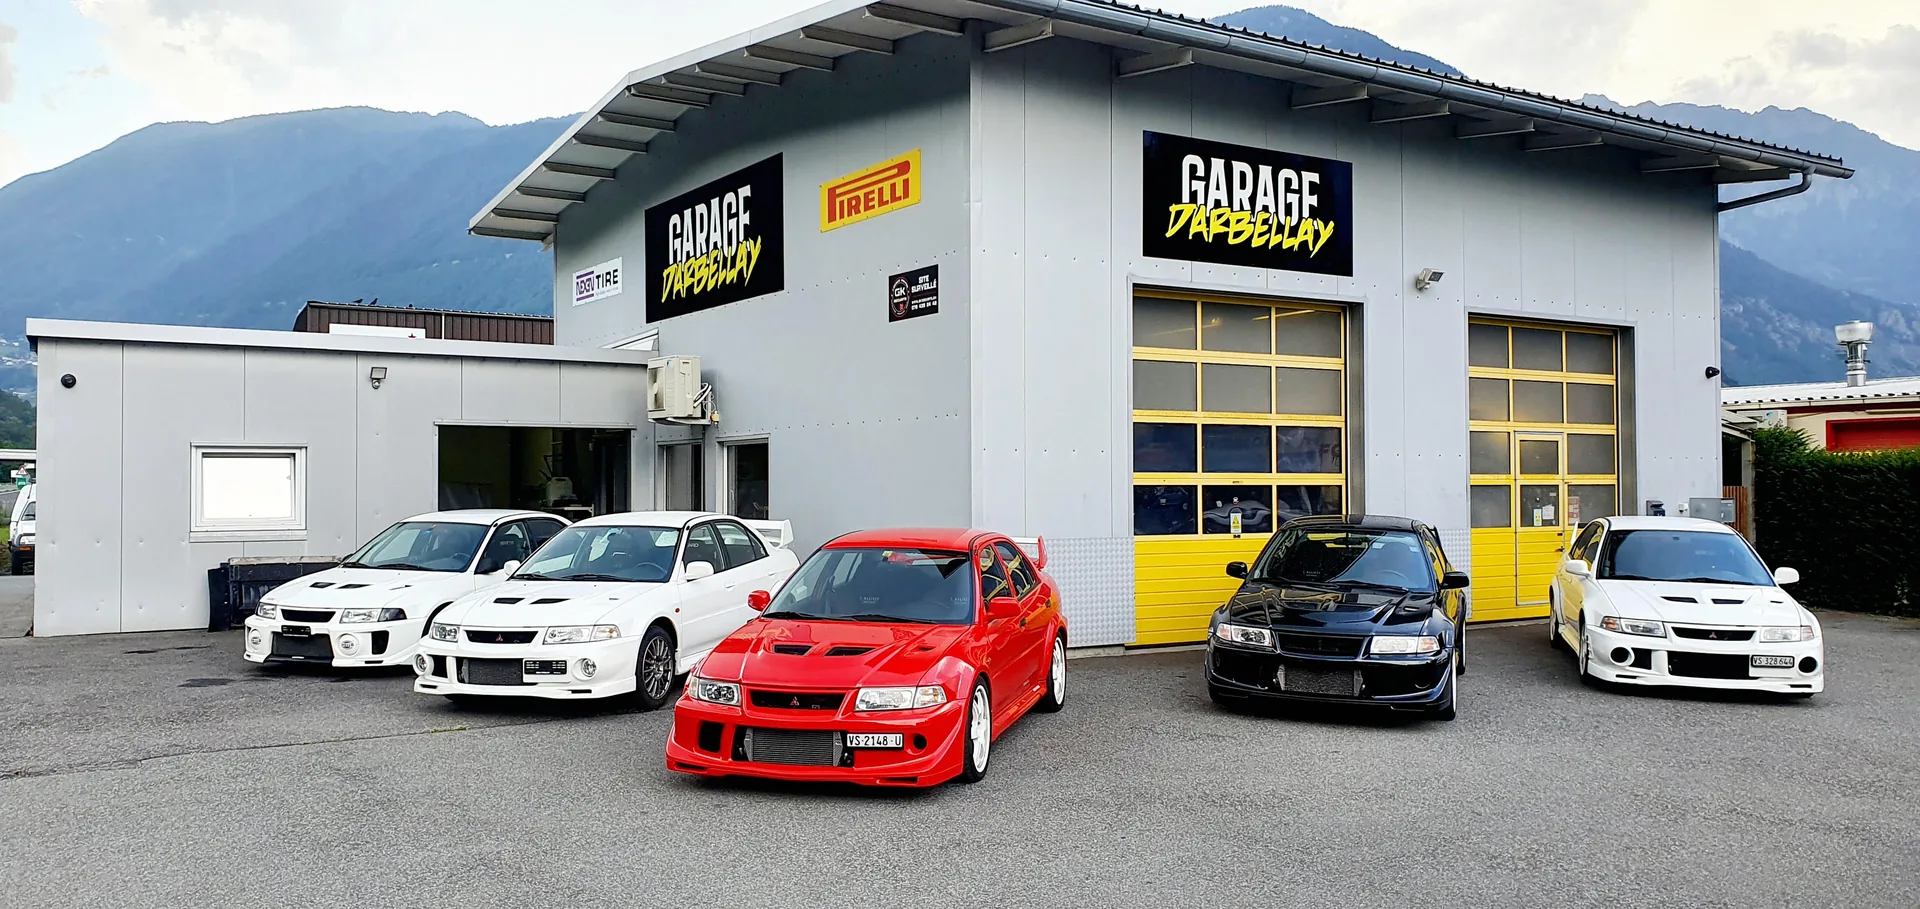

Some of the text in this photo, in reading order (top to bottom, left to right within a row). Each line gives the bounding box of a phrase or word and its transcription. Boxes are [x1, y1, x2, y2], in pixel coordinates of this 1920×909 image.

[827, 159, 911, 224] PIRELLI
[1182, 154, 1320, 230] GARAGE
[668, 184, 752, 268] GARAGE
[1164, 202, 1335, 258] DARBELLAY
[595, 268, 619, 290] TIRE
[661, 235, 762, 303] DARBELLAY
[895, 287, 905, 297] GK
[918, 275, 929, 284] SITE
[848, 736, 901, 746] VS 2148 U
